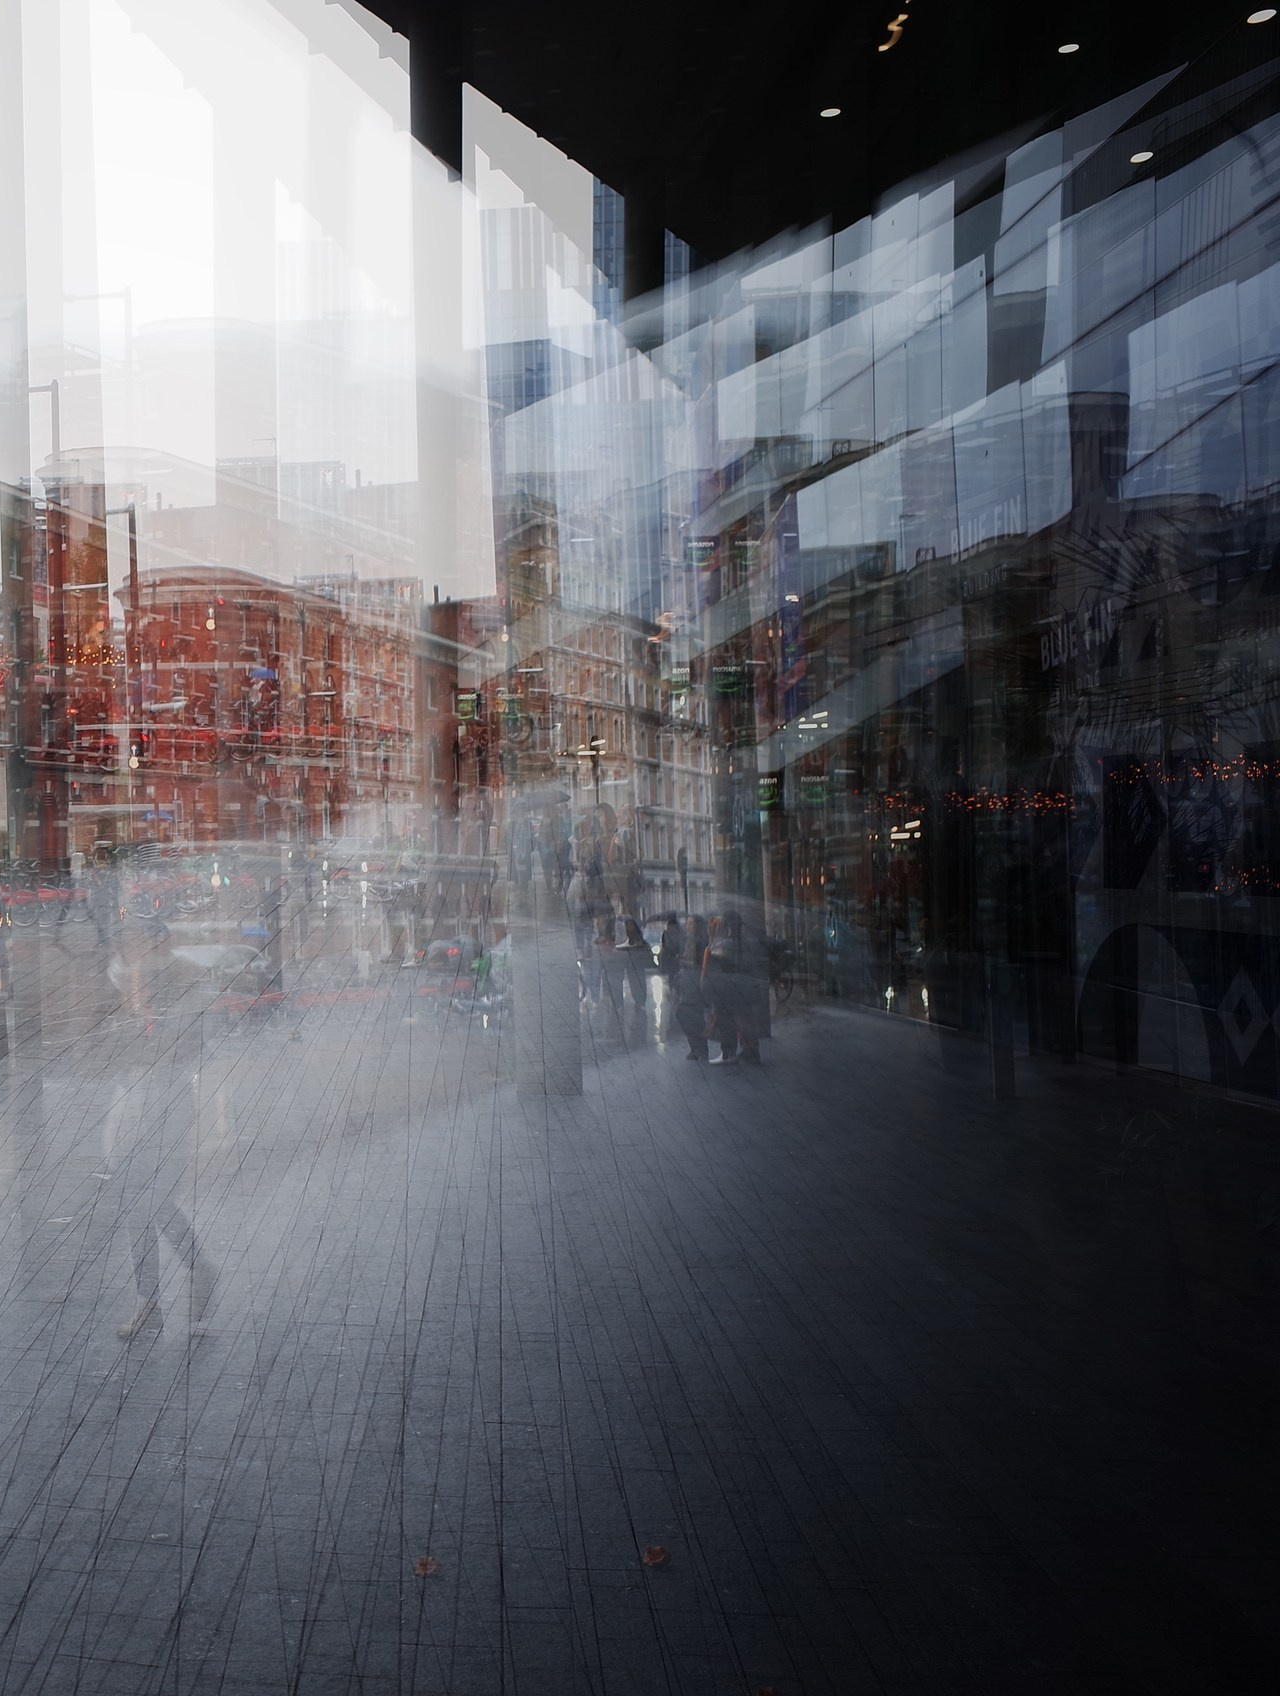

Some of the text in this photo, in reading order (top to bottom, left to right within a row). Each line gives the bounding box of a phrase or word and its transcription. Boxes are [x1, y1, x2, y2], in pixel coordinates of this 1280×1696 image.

[950, 493, 1022, 566] BLUE FIN
[963, 562, 1008, 598] BUILDING
[1040, 619, 1079, 673] BLUE
